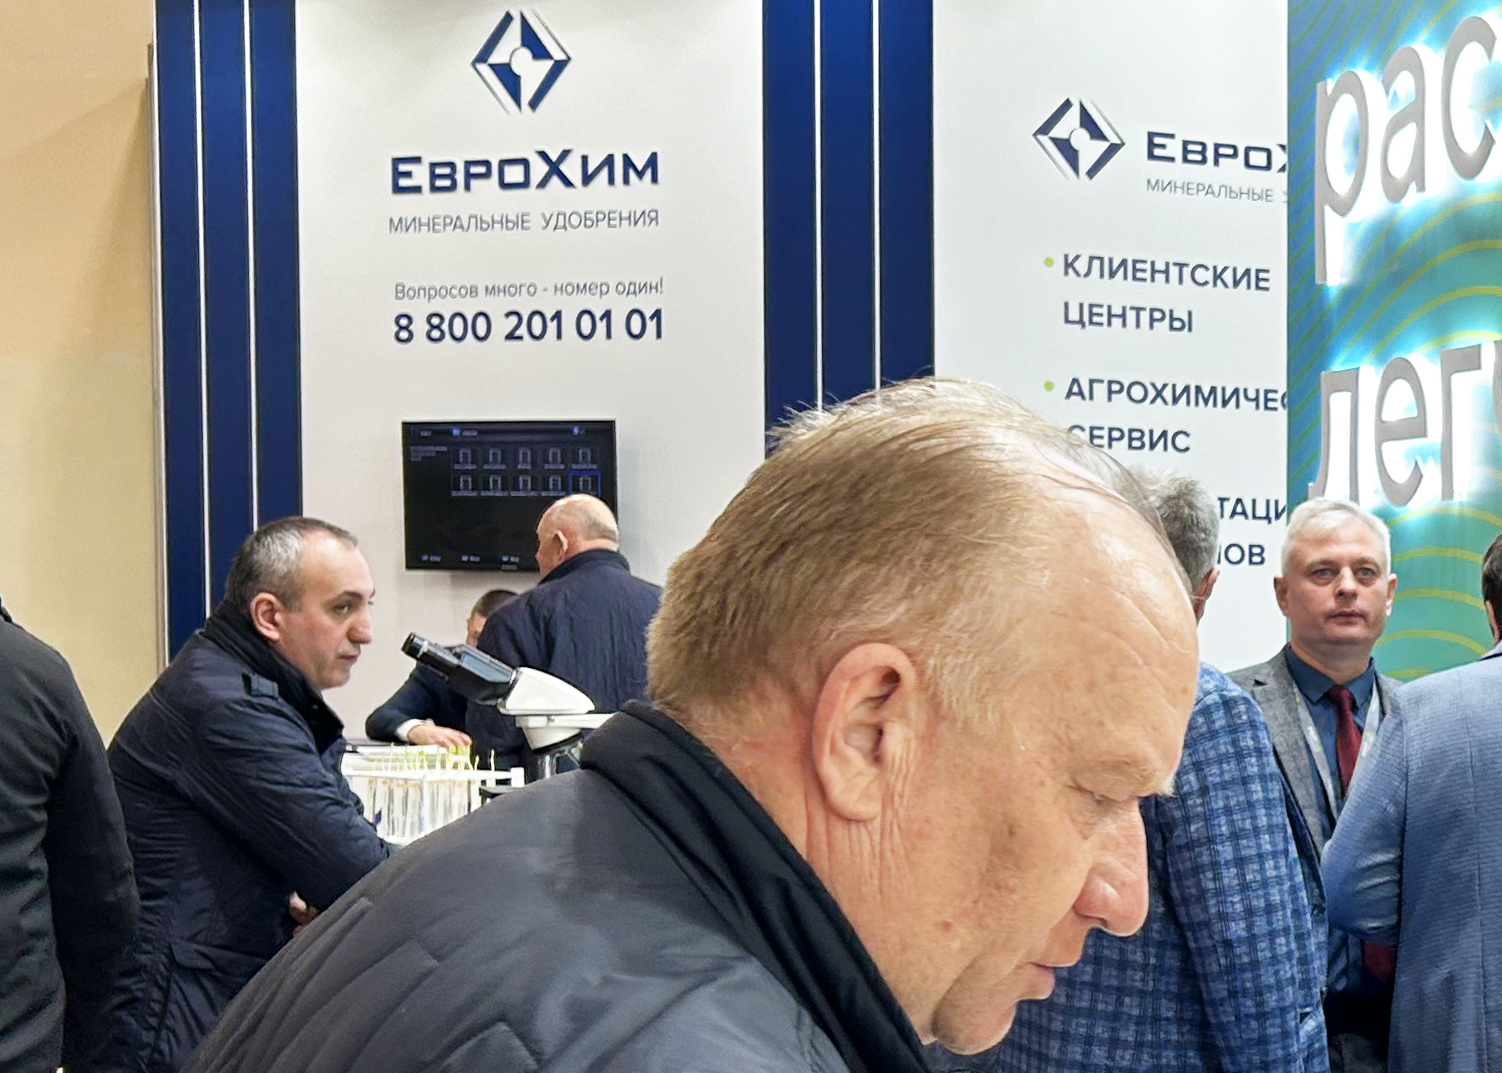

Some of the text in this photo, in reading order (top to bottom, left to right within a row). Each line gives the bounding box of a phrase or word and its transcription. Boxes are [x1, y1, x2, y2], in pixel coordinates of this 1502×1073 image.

[1146, 177, 1275, 203] МИНЕРАЛЬНЫЕ
[388, 208, 660, 235] МИНЕРАЛЬНЫЕ УДОБРЕНИЯ
[1062, 253, 1271, 292] КЛИЕНТСКИЕ
[394, 281, 480, 303] Вопросов
[484, 281, 538, 299] много
[553, 279, 611, 300] номер
[614, 276, 665, 297] один!
[393, 307, 664, 344] 8 800 201 01 01
[1063, 300, 1194, 334] ЦЕНТРЫ
